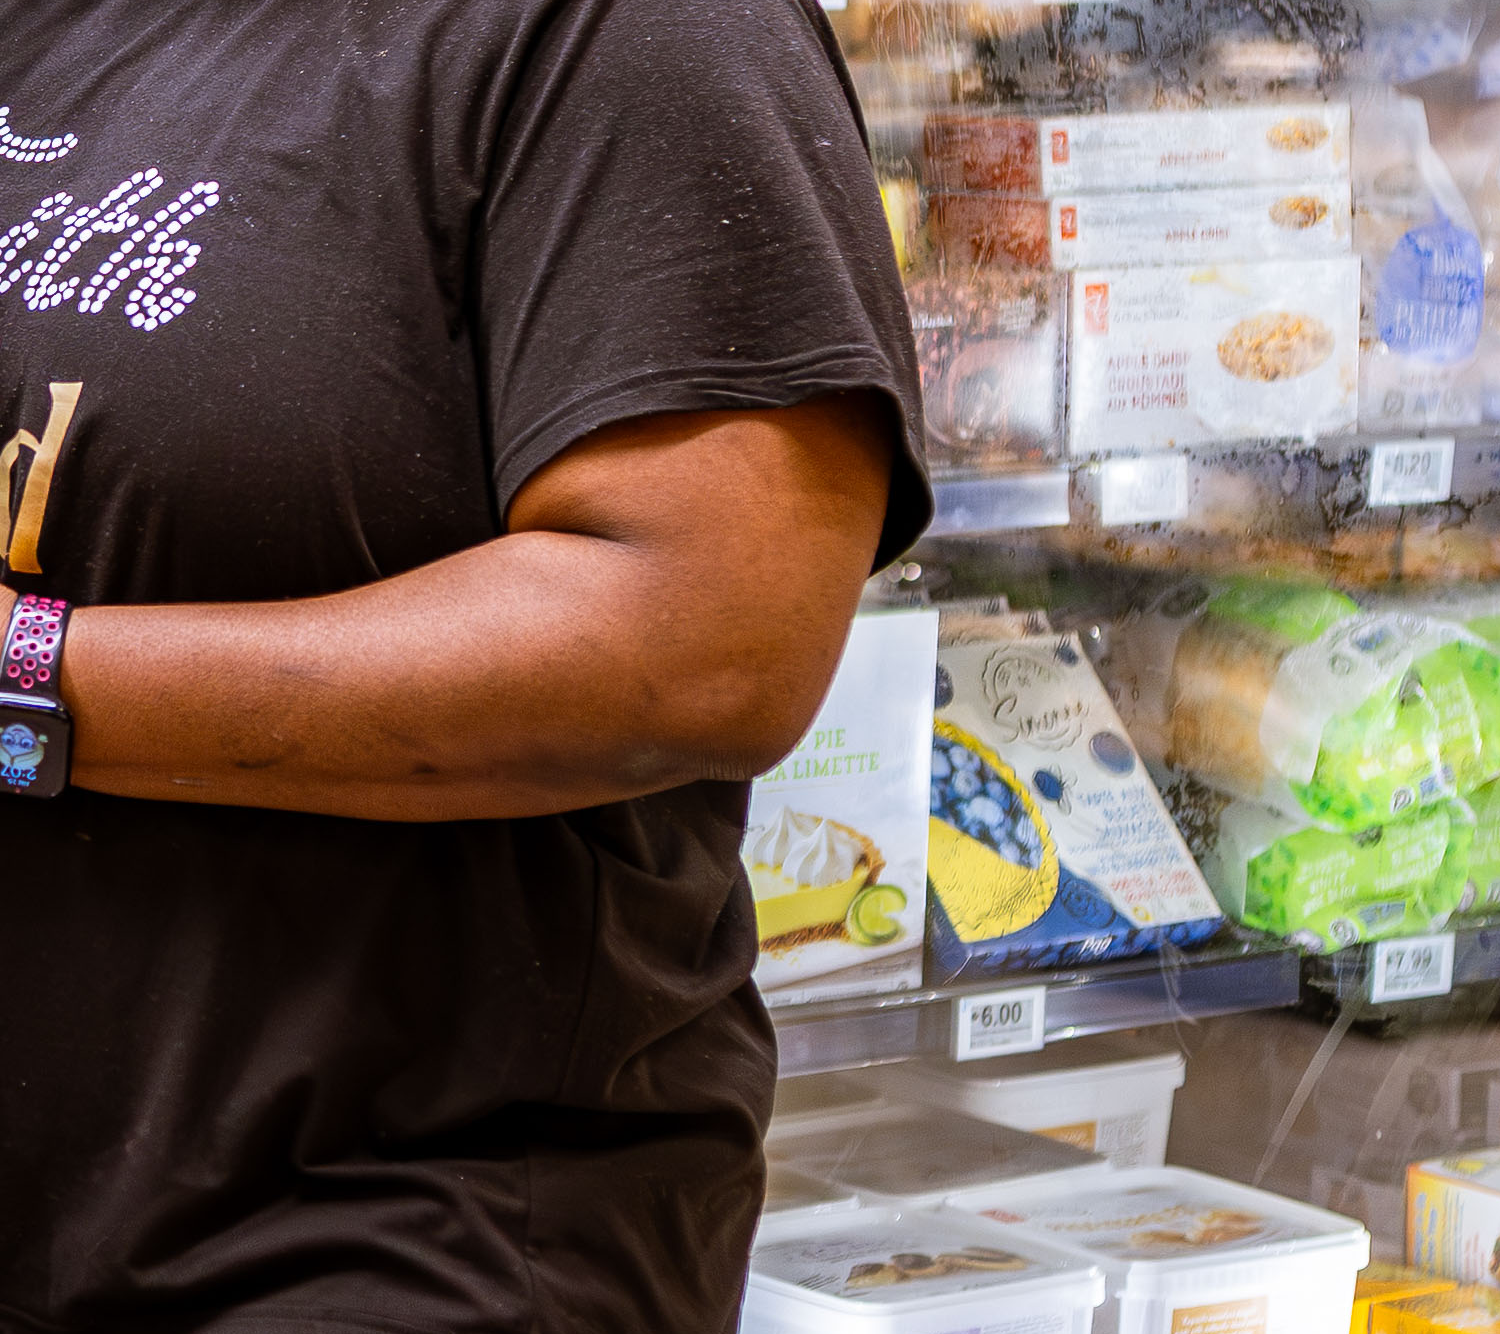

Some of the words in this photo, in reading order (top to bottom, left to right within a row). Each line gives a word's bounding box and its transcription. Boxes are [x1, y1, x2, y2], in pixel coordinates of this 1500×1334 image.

[814, 728, 845, 748] PIE
[0, 764, 37, 781] 2:07
[792, 751, 880, 776] LIMETTE
[981, 1002, 1022, 1027] 6.00
